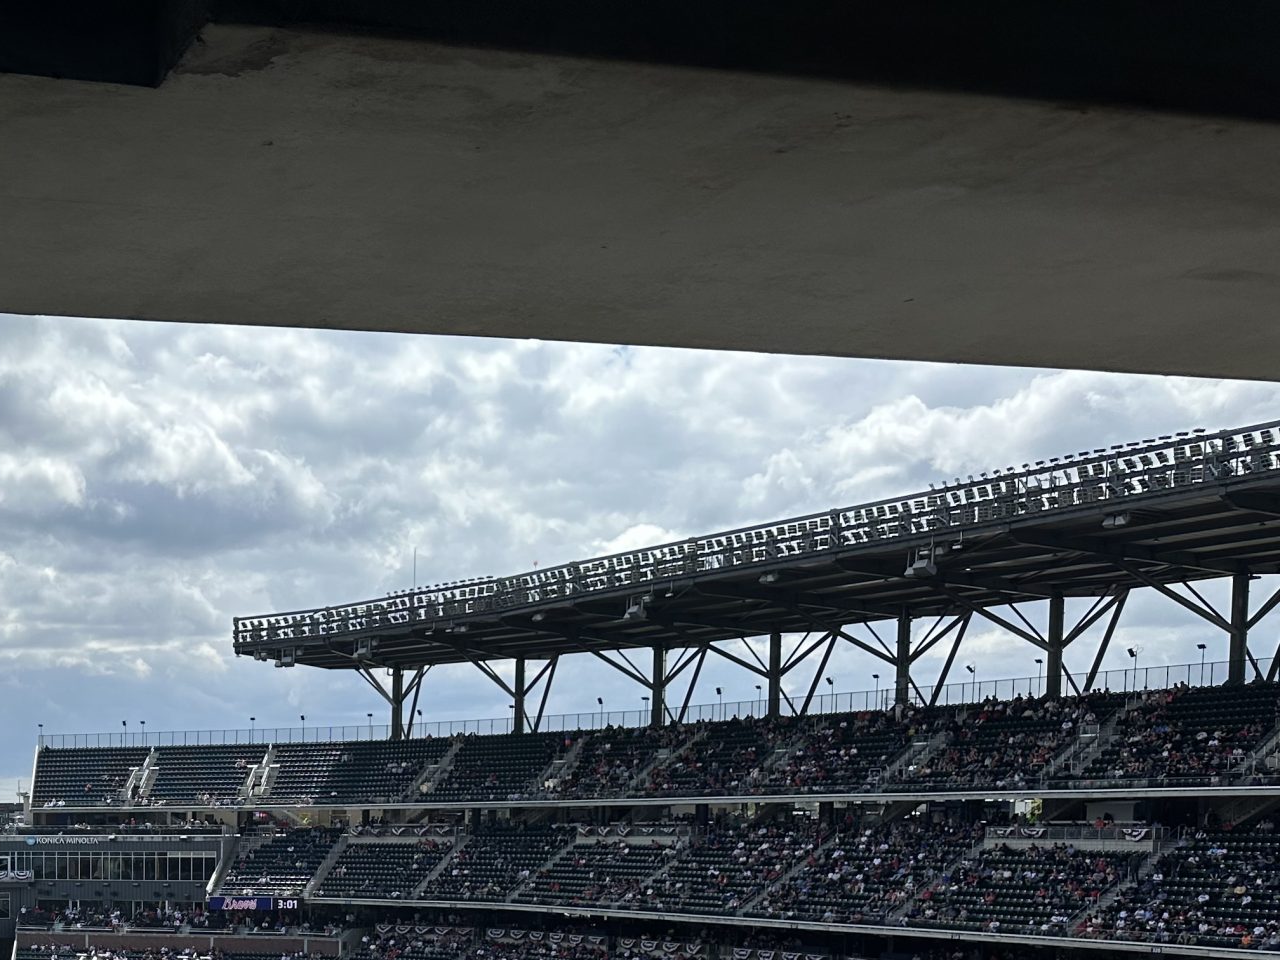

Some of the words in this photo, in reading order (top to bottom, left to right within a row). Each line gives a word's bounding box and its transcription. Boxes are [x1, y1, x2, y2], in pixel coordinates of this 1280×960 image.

[37, 837, 64, 845] KONICA
[66, 837, 99, 845] MINOLTA
[278, 900, 297, 909] 3:01
